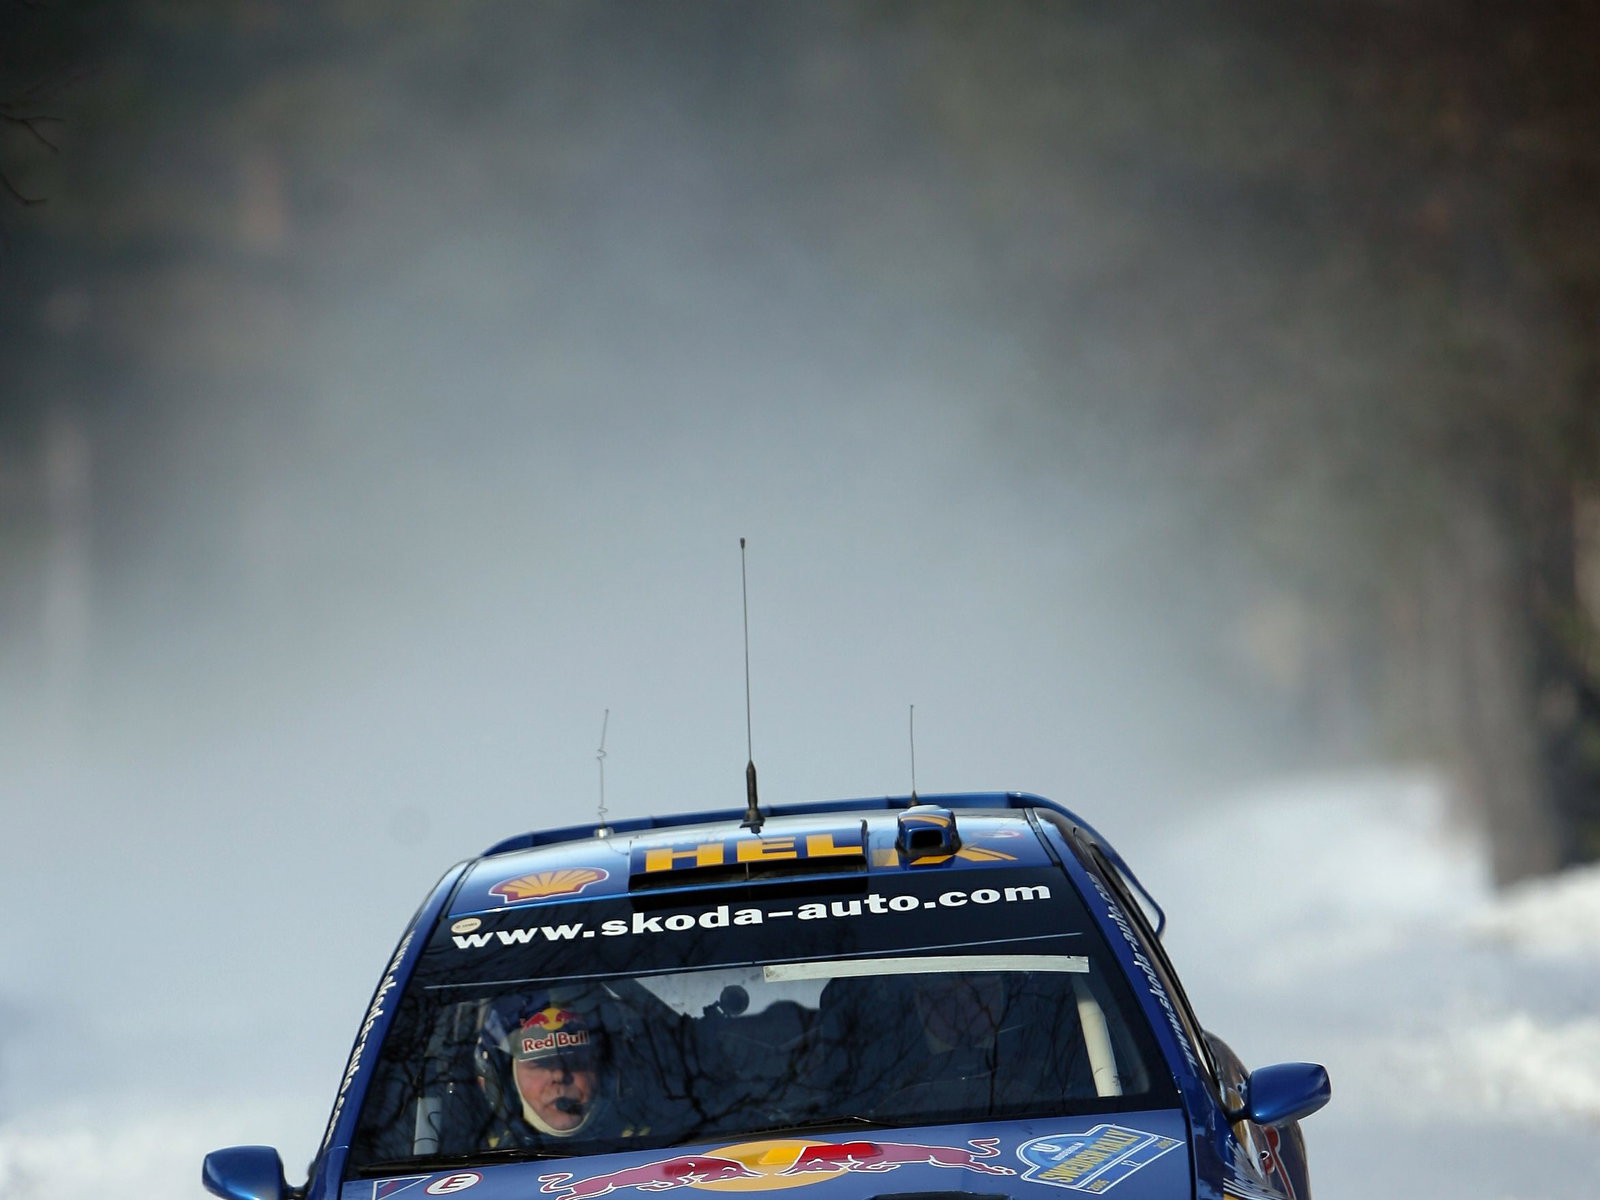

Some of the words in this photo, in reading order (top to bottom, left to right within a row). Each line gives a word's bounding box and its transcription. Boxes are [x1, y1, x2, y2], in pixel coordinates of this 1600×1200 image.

[452, 884, 1051, 949] www.skoda-auto.com
[522, 1032, 556, 1053] Red
[556, 1030, 591, 1048] Bull
[1092, 1128, 1141, 1159] RALLY
